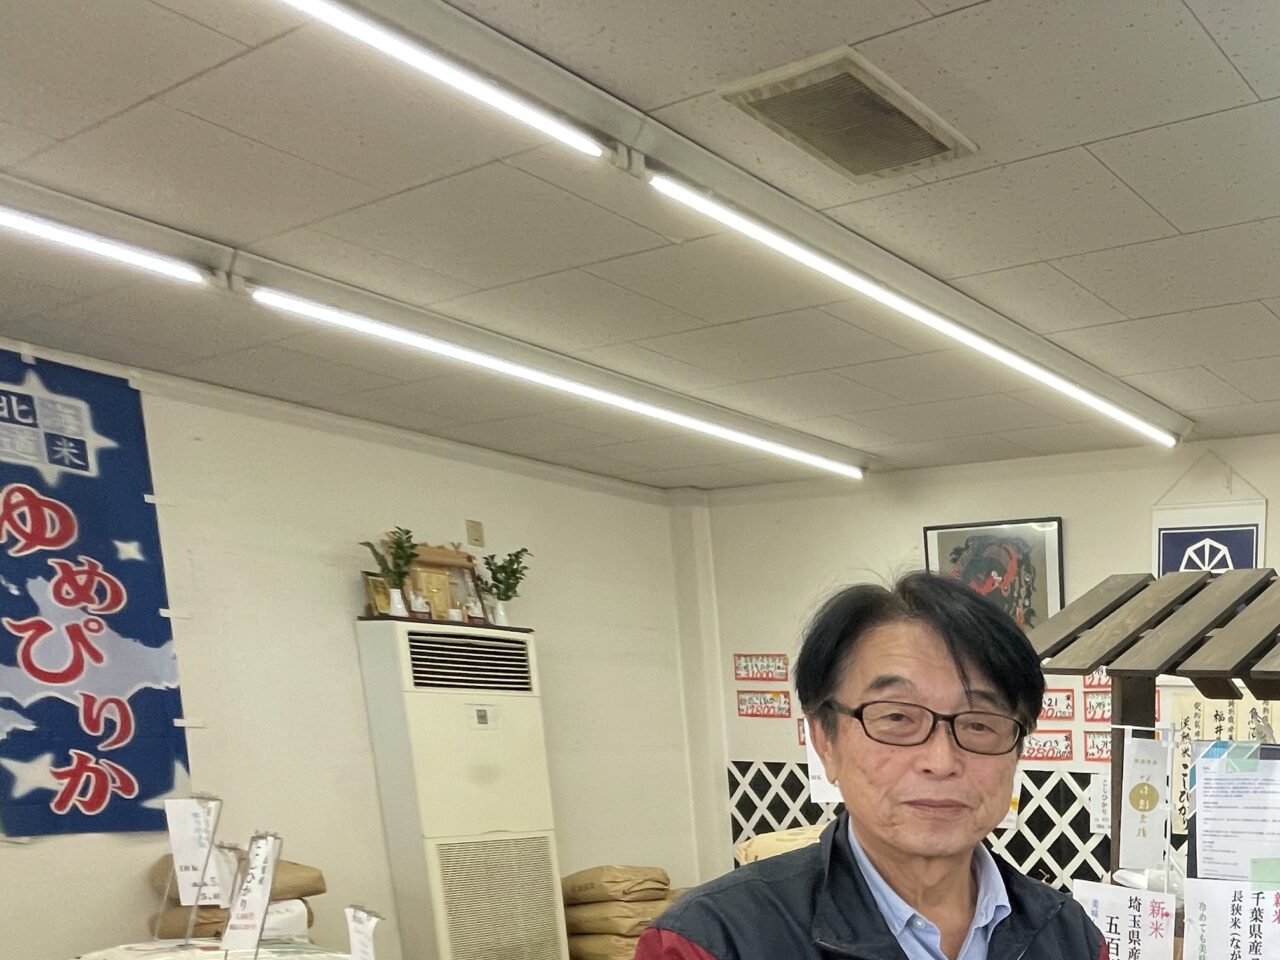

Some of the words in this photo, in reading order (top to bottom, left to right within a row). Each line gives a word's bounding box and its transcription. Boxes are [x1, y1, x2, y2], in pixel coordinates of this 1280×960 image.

[0, 484, 139, 816] ゆめぴりか
[1213, 709, 1226, 740] 福井
[1148, 899, 1166, 939] 新米
